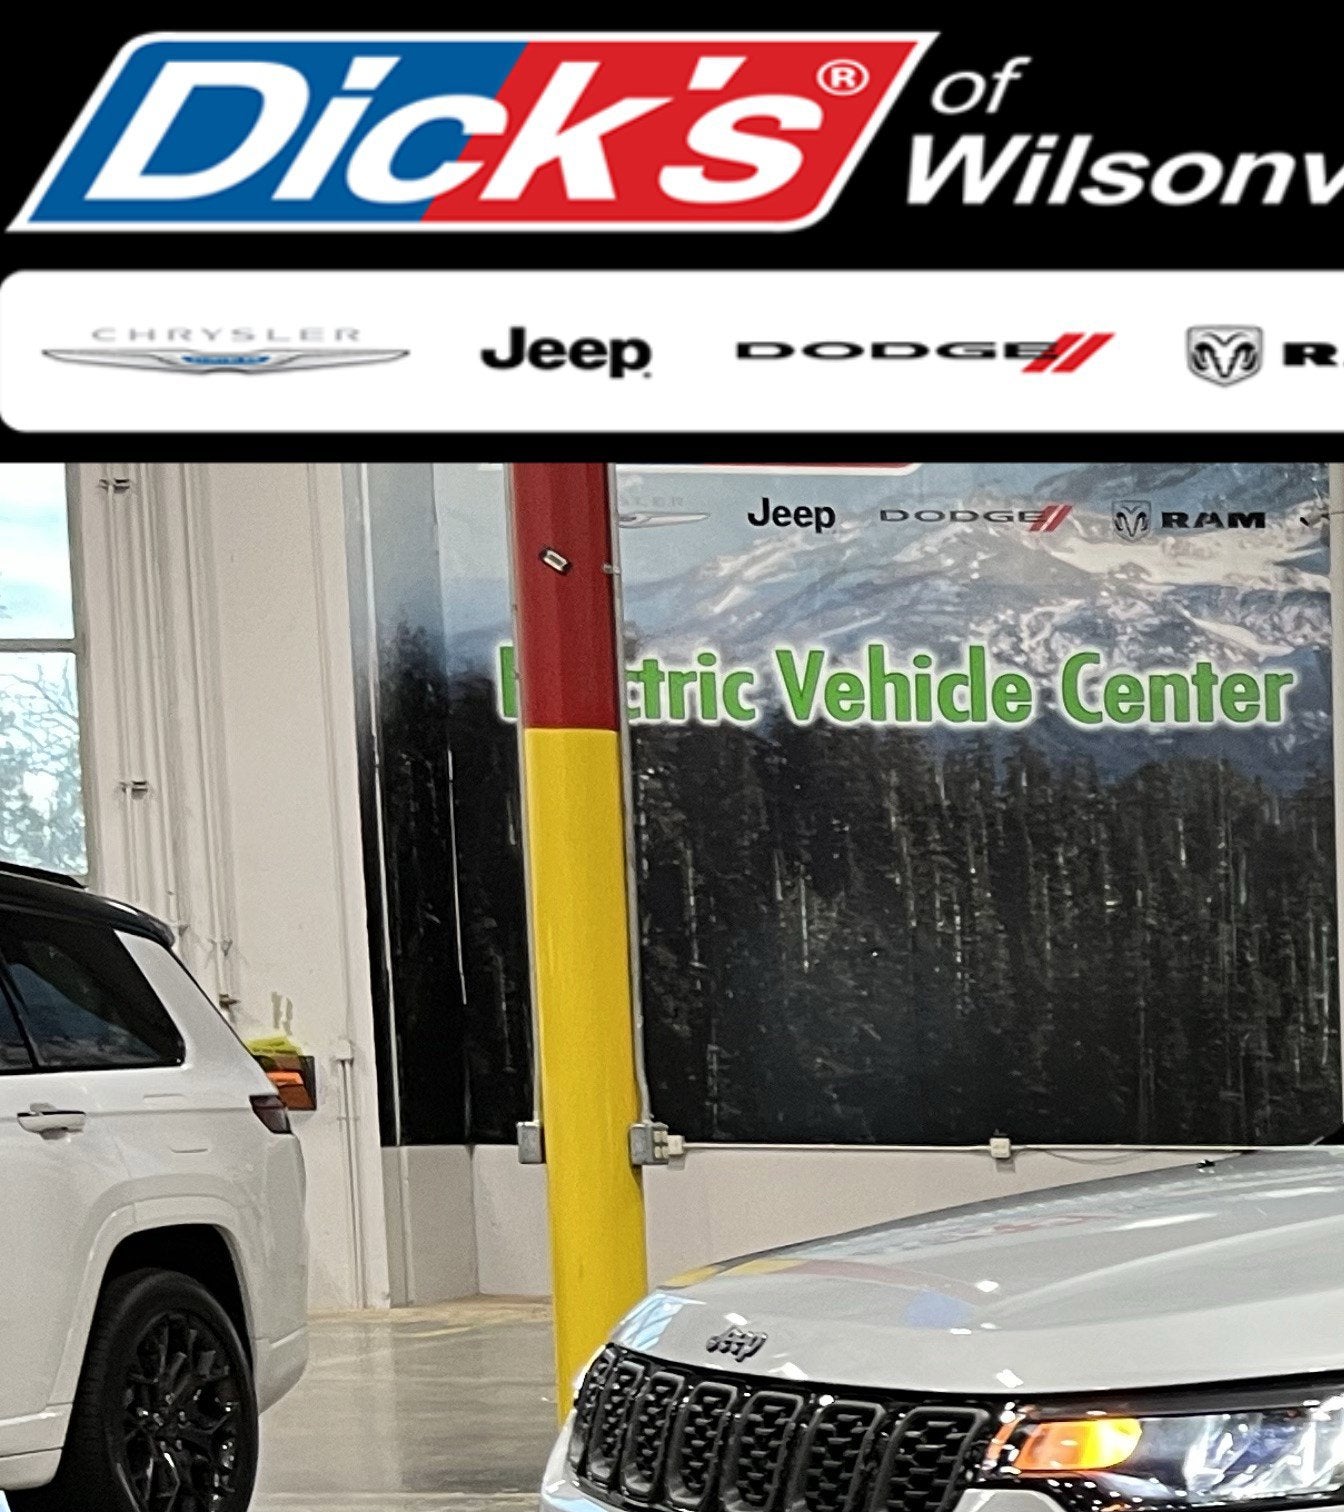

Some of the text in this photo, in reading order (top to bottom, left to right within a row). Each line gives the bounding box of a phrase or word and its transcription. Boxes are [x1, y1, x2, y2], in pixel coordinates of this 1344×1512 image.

[747, 496, 836, 534] Jeep
[879, 508, 1046, 523] DODGE
[1160, 510, 1267, 530] RAM
[774, 643, 1033, 723] Vehicle
[1061, 650, 1295, 724] Center
[705, 1324, 768, 1363] Jeep
